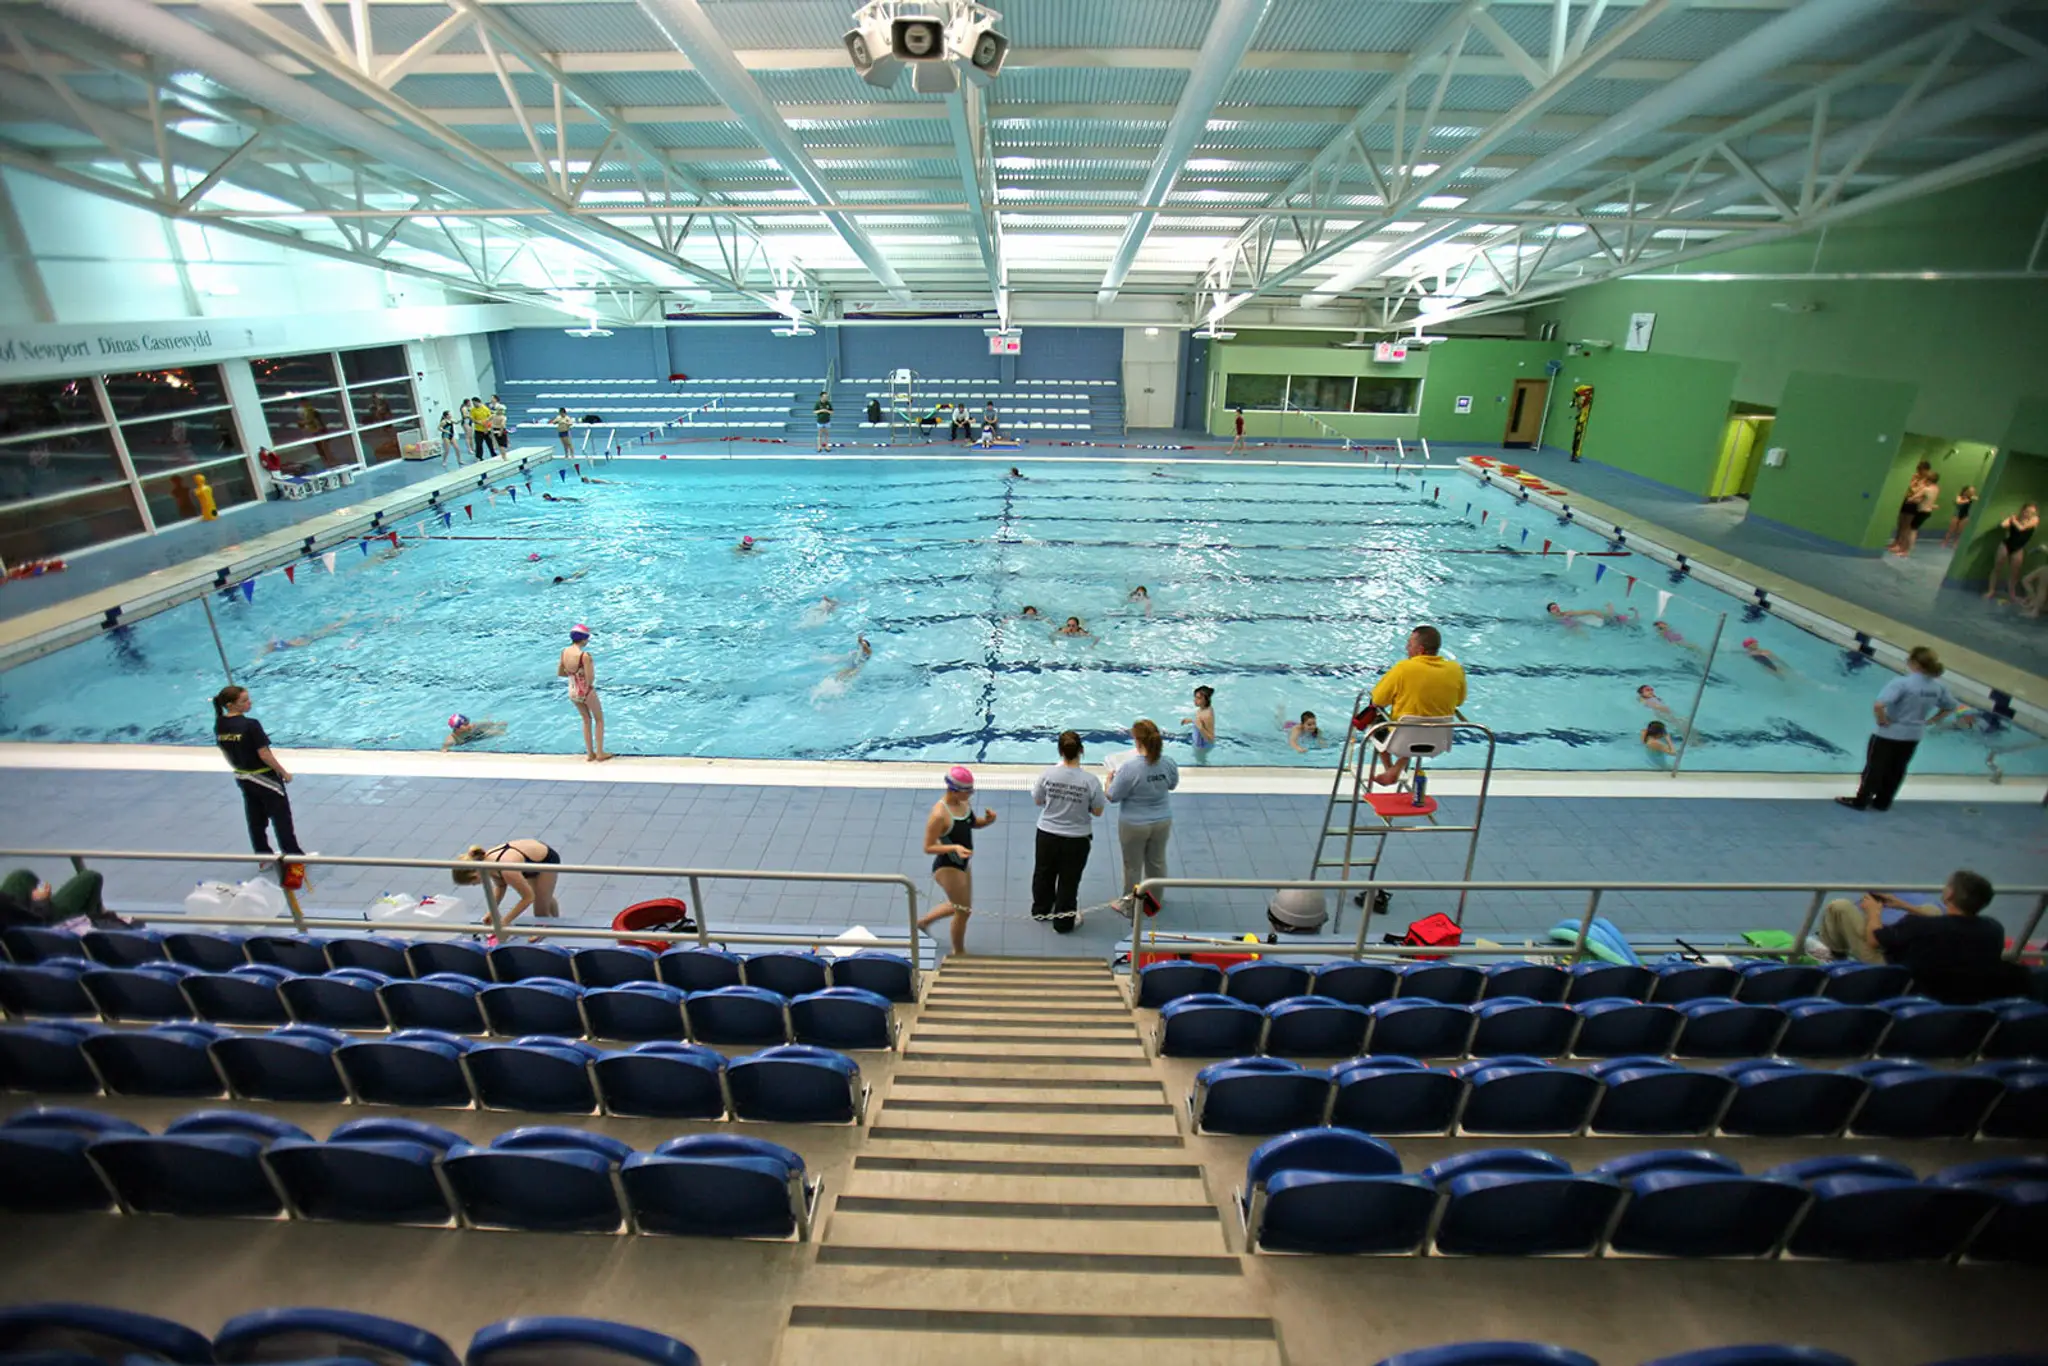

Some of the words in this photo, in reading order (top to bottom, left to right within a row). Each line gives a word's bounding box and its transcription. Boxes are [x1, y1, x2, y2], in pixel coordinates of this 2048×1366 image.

[19, 340, 91, 363] Newport
[98, 337, 140, 354] Dinas
[141, 330, 212, 352] Casnewydd
